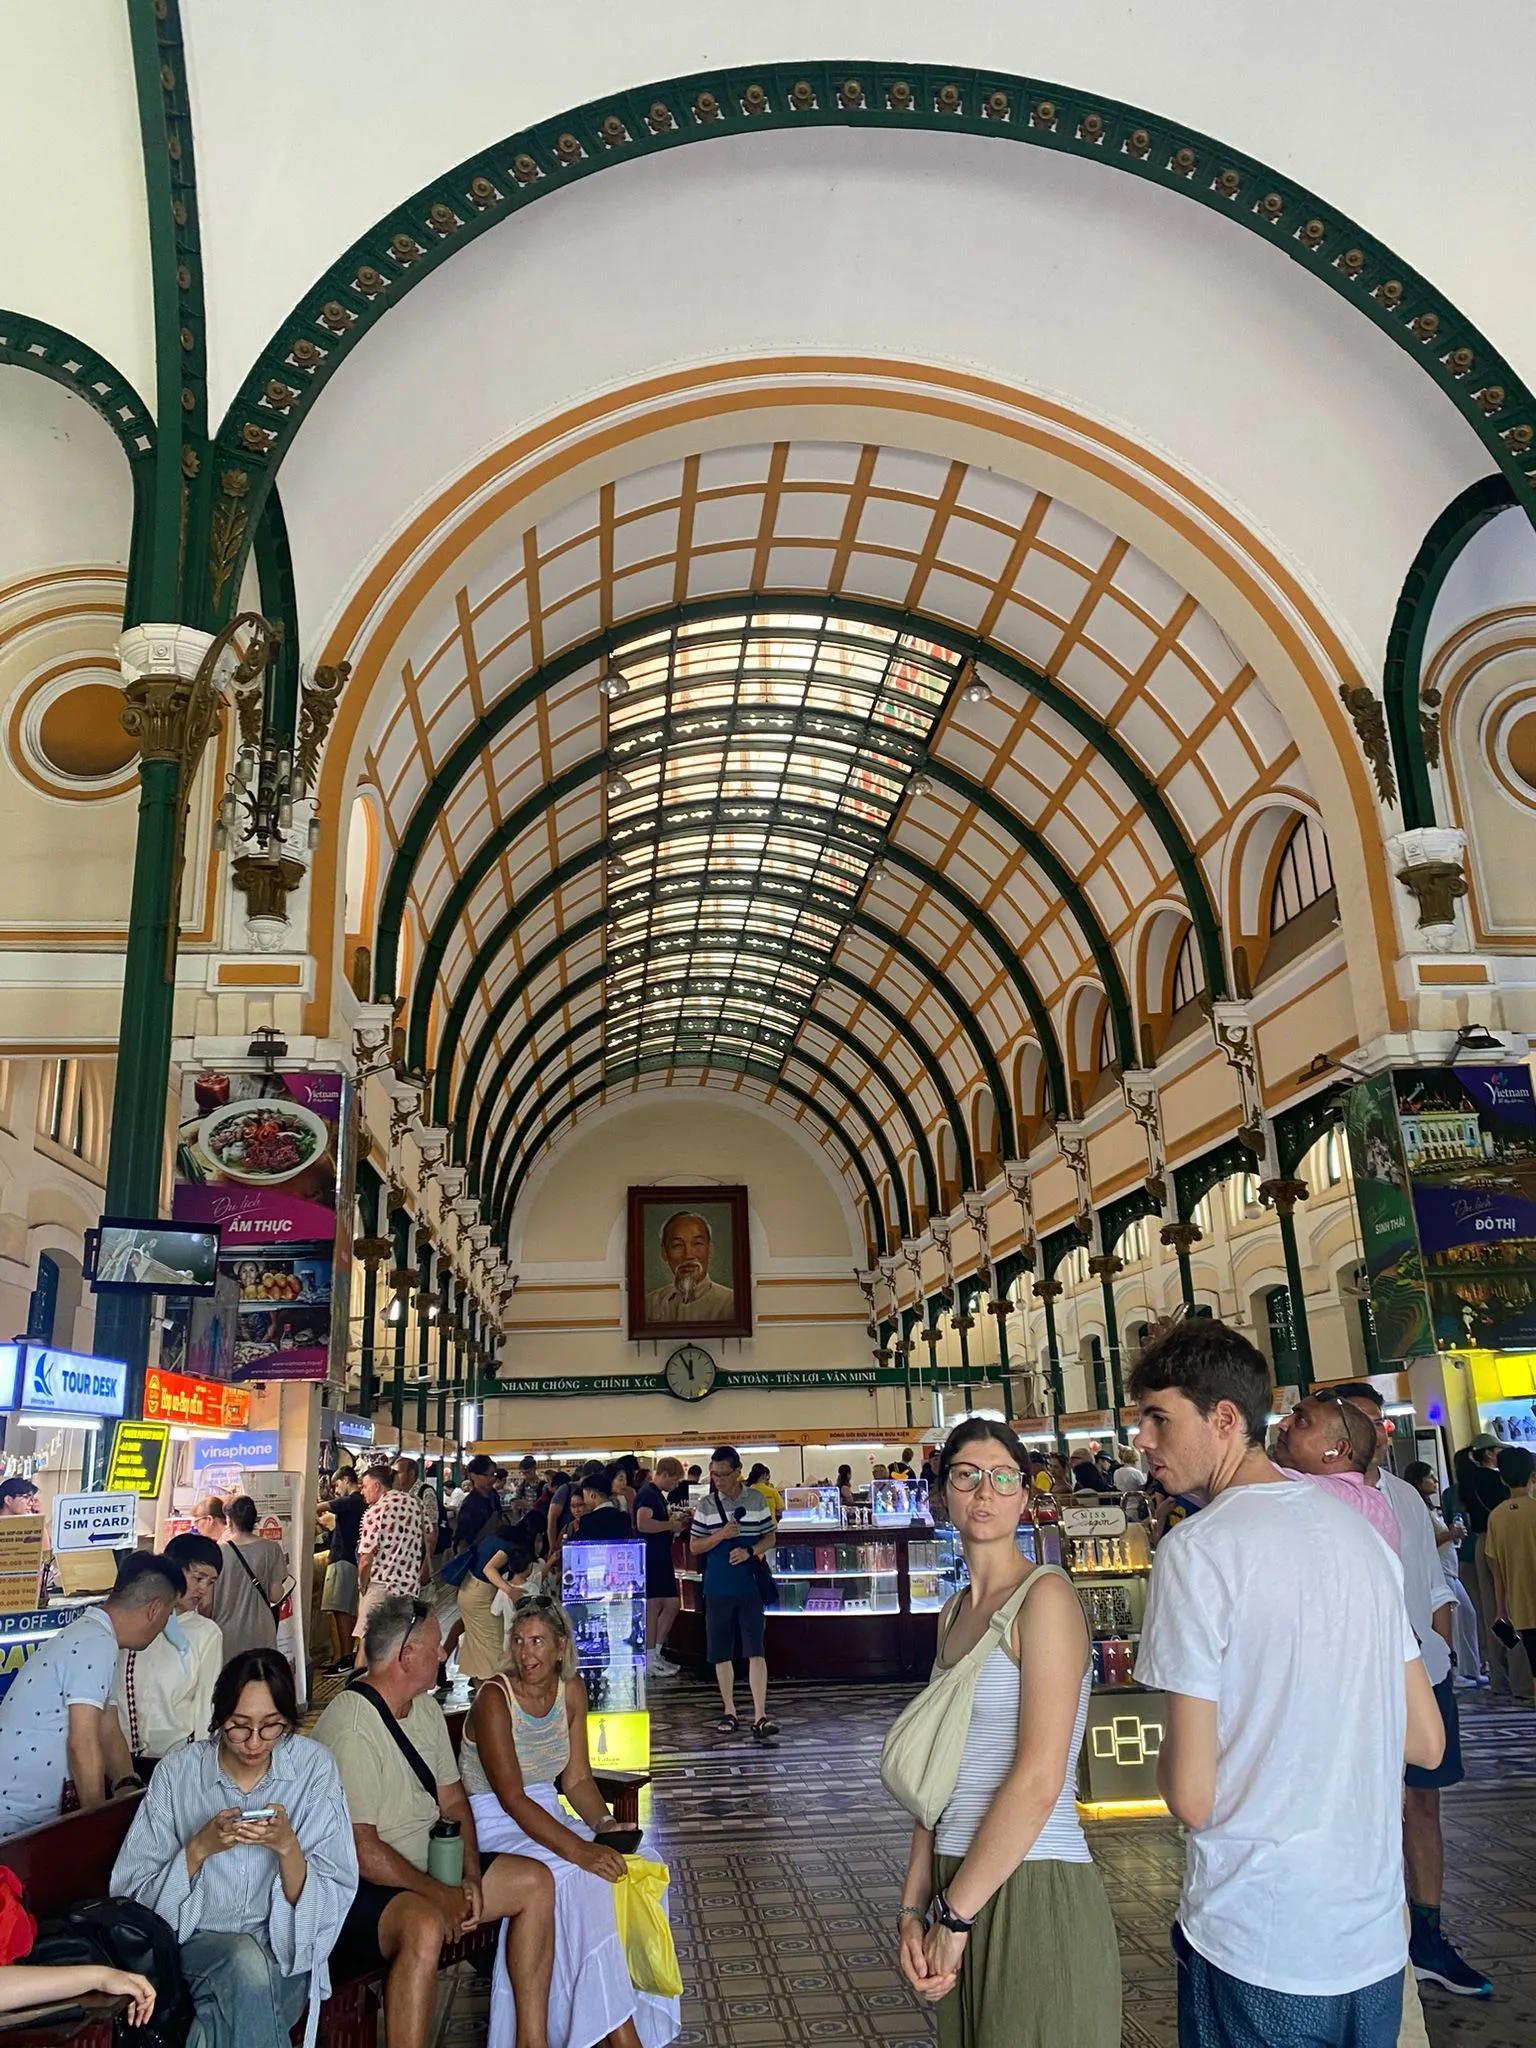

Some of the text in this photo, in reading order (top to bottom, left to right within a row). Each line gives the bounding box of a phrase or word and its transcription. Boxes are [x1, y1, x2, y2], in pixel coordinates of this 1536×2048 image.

[1483, 1081, 1530, 1104] Vietnam
[254, 1219, 293, 1235] THỰC
[1475, 1216, 1516, 1232] ĐÔ THỊ
[62, 1370, 117, 1397] TOUR DESK
[501, 1381, 538, 1391] NHANH
[542, 1378, 580, 1389] CHÓNG
[593, 1376, 629, 1388] CHÍNH
[634, 1376, 657, 1387] XÁC
[727, 1375, 740, 1384] AN
[742, 1373, 769, 1384] TOÀN
[776, 1372, 800, 1385] TIỆN
[802, 1373, 819, 1384] LỢI
[827, 1371, 849, 1382] VĂN
[850, 1372, 876, 1381] MINH
[201, 1444, 273, 1458] vinaphone
[69, 1505, 126, 1516] INTERNET
[63, 1517, 129, 1530] SIM CARD
[0, 1618, 15, 1632] P
[19, 1614, 48, 1630] OFF
